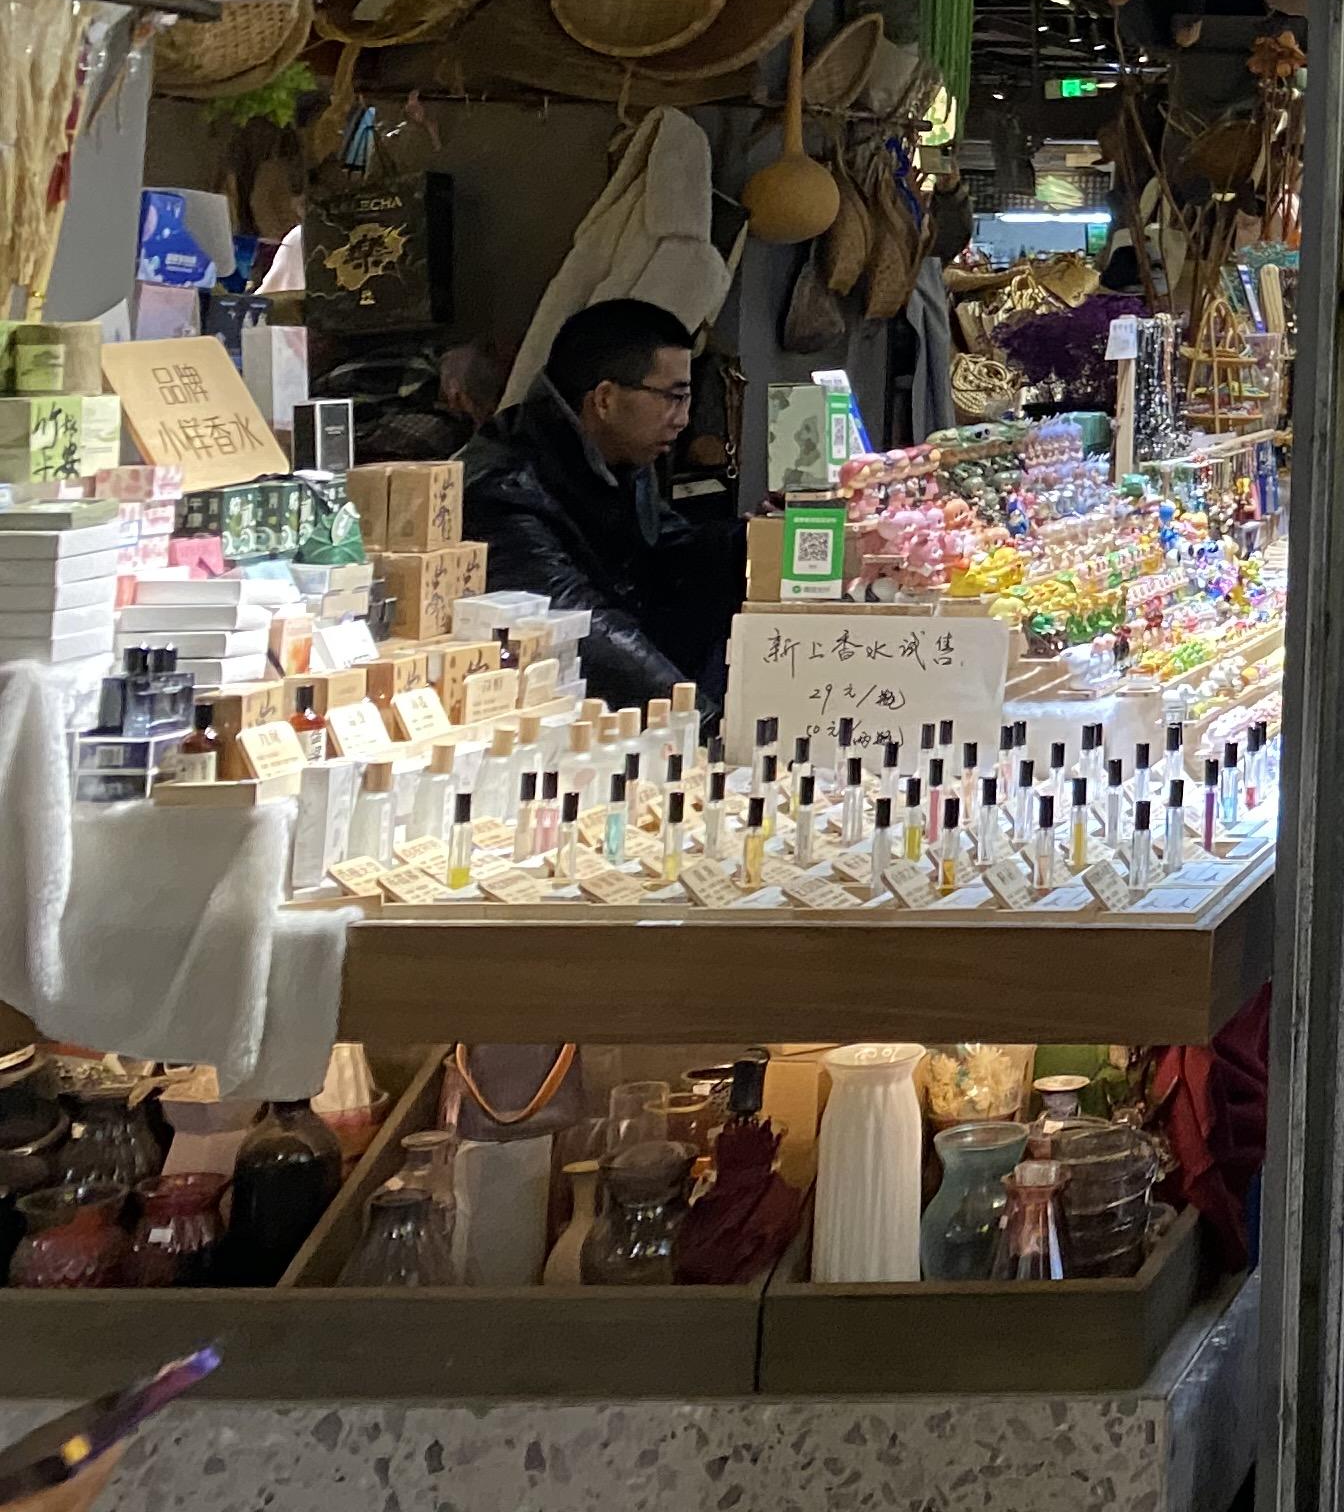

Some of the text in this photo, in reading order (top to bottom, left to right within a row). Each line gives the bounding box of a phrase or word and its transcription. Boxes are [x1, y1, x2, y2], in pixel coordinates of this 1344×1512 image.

[152, 363, 209, 406] 品牌
[158, 412, 264, 461] 小样香水
